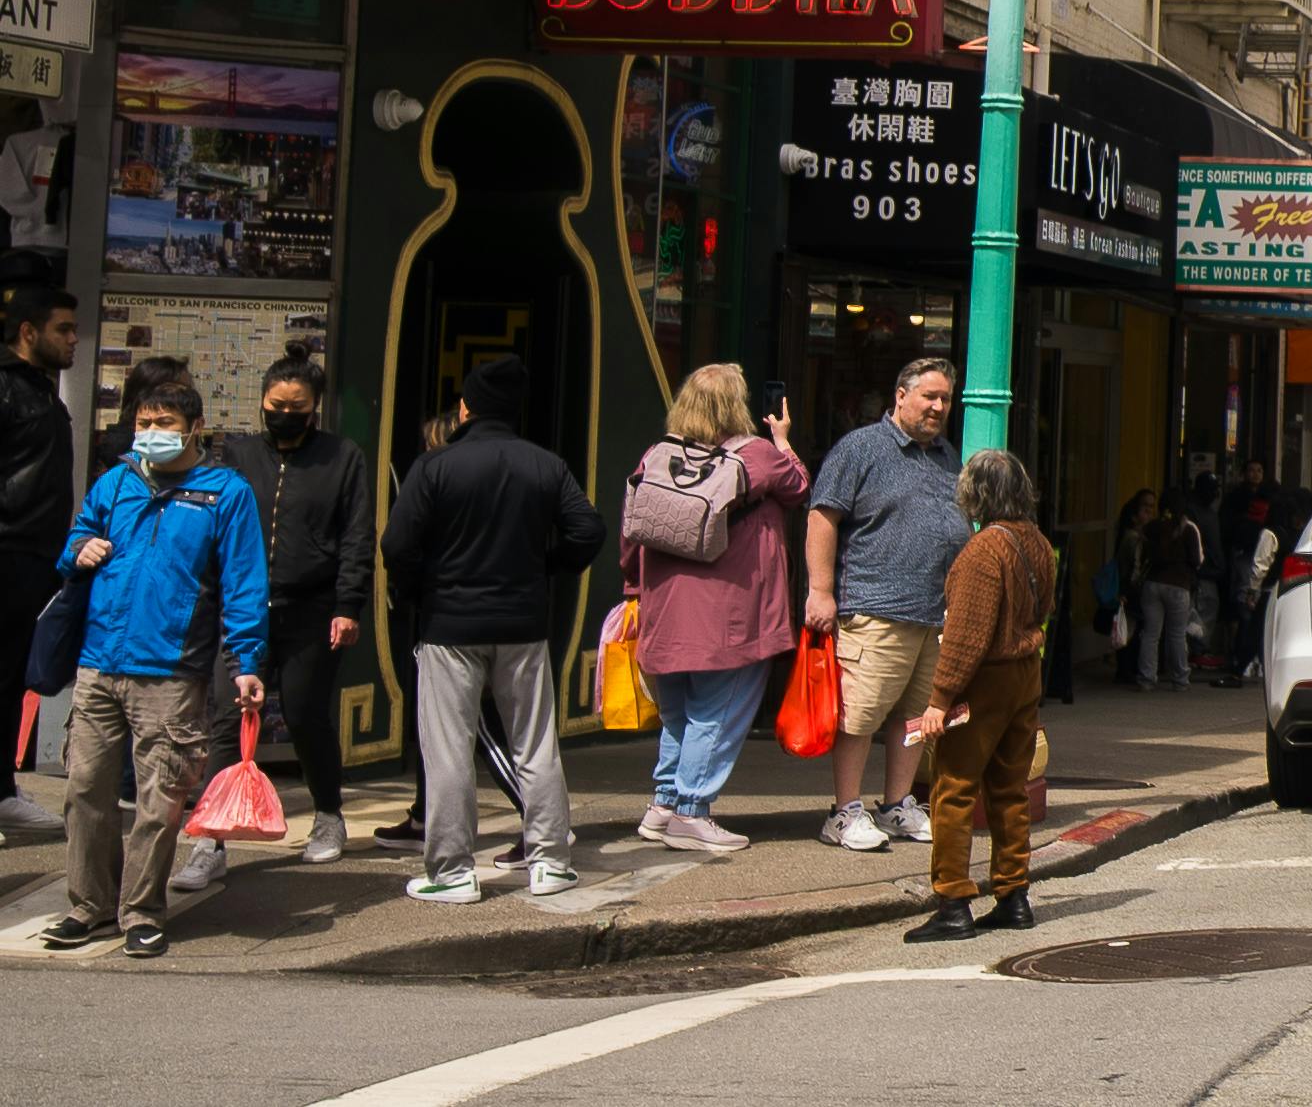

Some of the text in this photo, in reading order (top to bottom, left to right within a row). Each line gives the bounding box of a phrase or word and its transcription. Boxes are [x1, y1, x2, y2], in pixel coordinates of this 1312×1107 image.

[831, 78, 953, 109] 臺灣胸圍
[888, 156, 977, 185] shoes
[1206, 170, 1272, 185] SOMETHING
[853, 195, 921, 221] 903
[1125, 185, 1160, 214] Boutique
[1183, 266, 1207, 279] THE
[1213, 266, 1268, 281] WONDER
[1273, 268, 1289, 282] OF
[107, 296, 325, 313] WELCOME TO SAN FRANCISCO CHINATOWN
